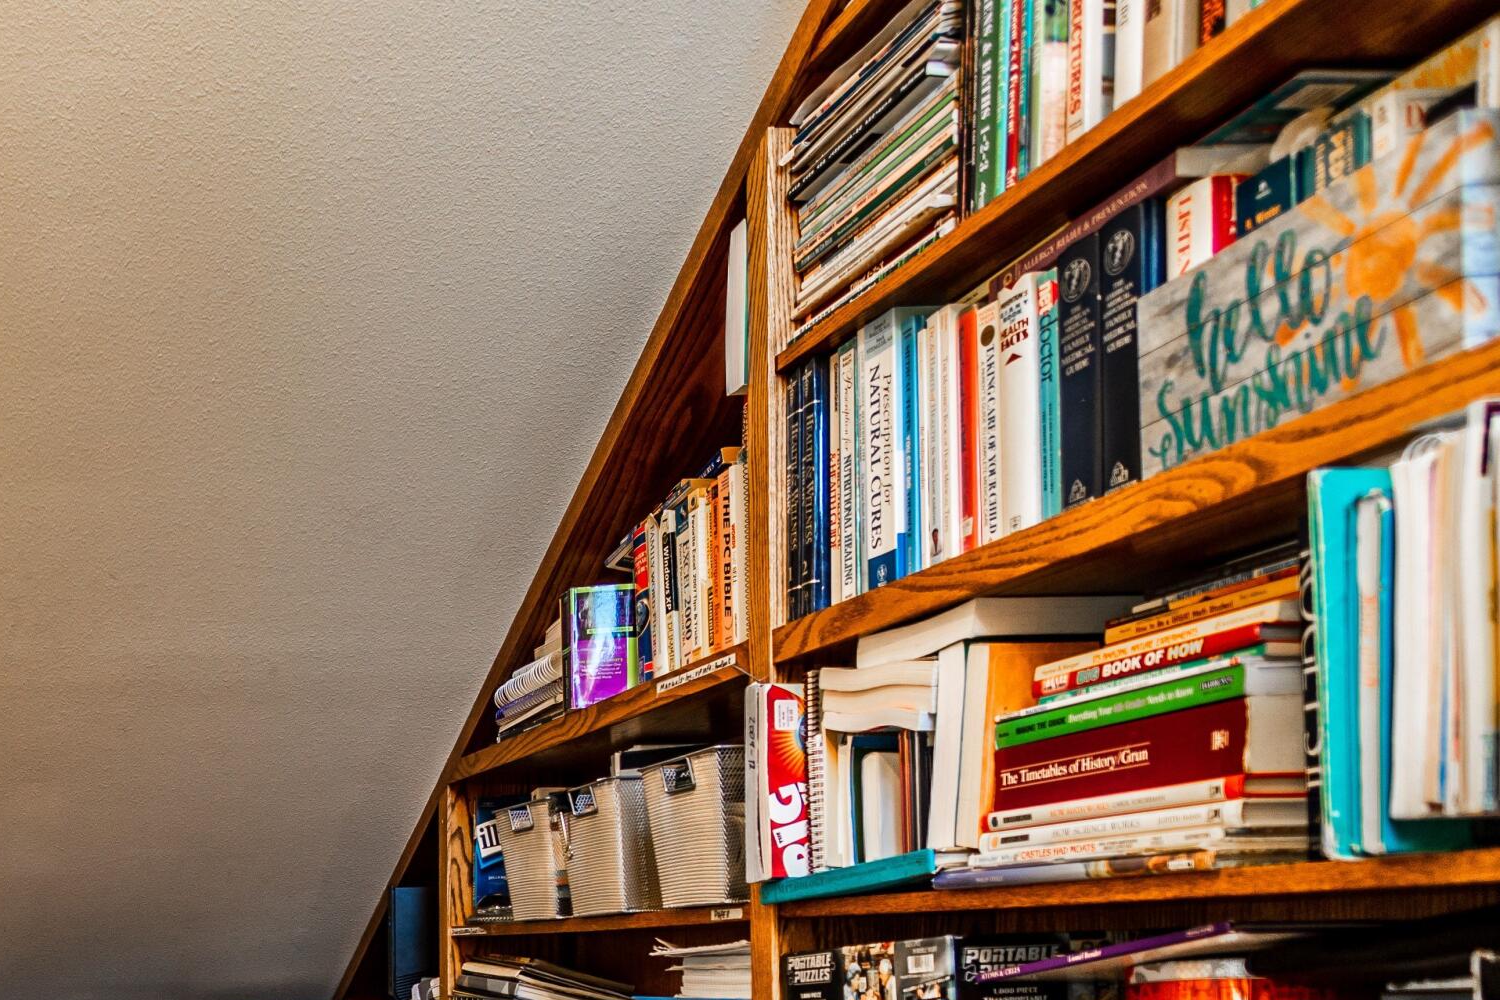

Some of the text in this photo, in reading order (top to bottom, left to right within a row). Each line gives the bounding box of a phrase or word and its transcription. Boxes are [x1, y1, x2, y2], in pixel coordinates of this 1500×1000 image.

[1186, 229, 1331, 394] hello
[986, 344, 996, 398] TAKING
[869, 364, 882, 472] NATURAL
[880, 373, 893, 506] Prescription for
[987, 399, 997, 433] CARE
[844, 453, 853, 532] NUTRITIONAL
[988, 455, 998, 490] YOUR
[869, 474, 882, 550] CURES
[988, 492, 998, 534] CHILD
[663, 545, 672, 594] Windows
[722, 493, 731, 617] THE PC BIBLE
[844, 533, 853, 586] HEALING
[665, 595, 672, 611] XP
[682, 540, 693, 642] EXCEL 2000
[1076, 667, 1100, 686] BIG
[1101, 656, 1141, 679] BOOK
[1144, 649, 1164, 668] OF
[1166, 637, 1204, 663] HOW
[1001, 771, 1019, 788] The
[1019, 763, 1069, 785] Timetables
[1068, 758, 1080, 775] of
[1020, 846, 1052, 861] CASTLES
[1052, 844, 1070, 859] HAD
[1070, 841, 1097, 857] MOATS
[1072, 822, 1108, 838] SCIENCE
[1109, 819, 1141, 834] WORKS
[788, 954, 831, 971] PORTABLE
[794, 968, 831, 983] PUZZLES
[965, 946, 1060, 964] PORTABLE
